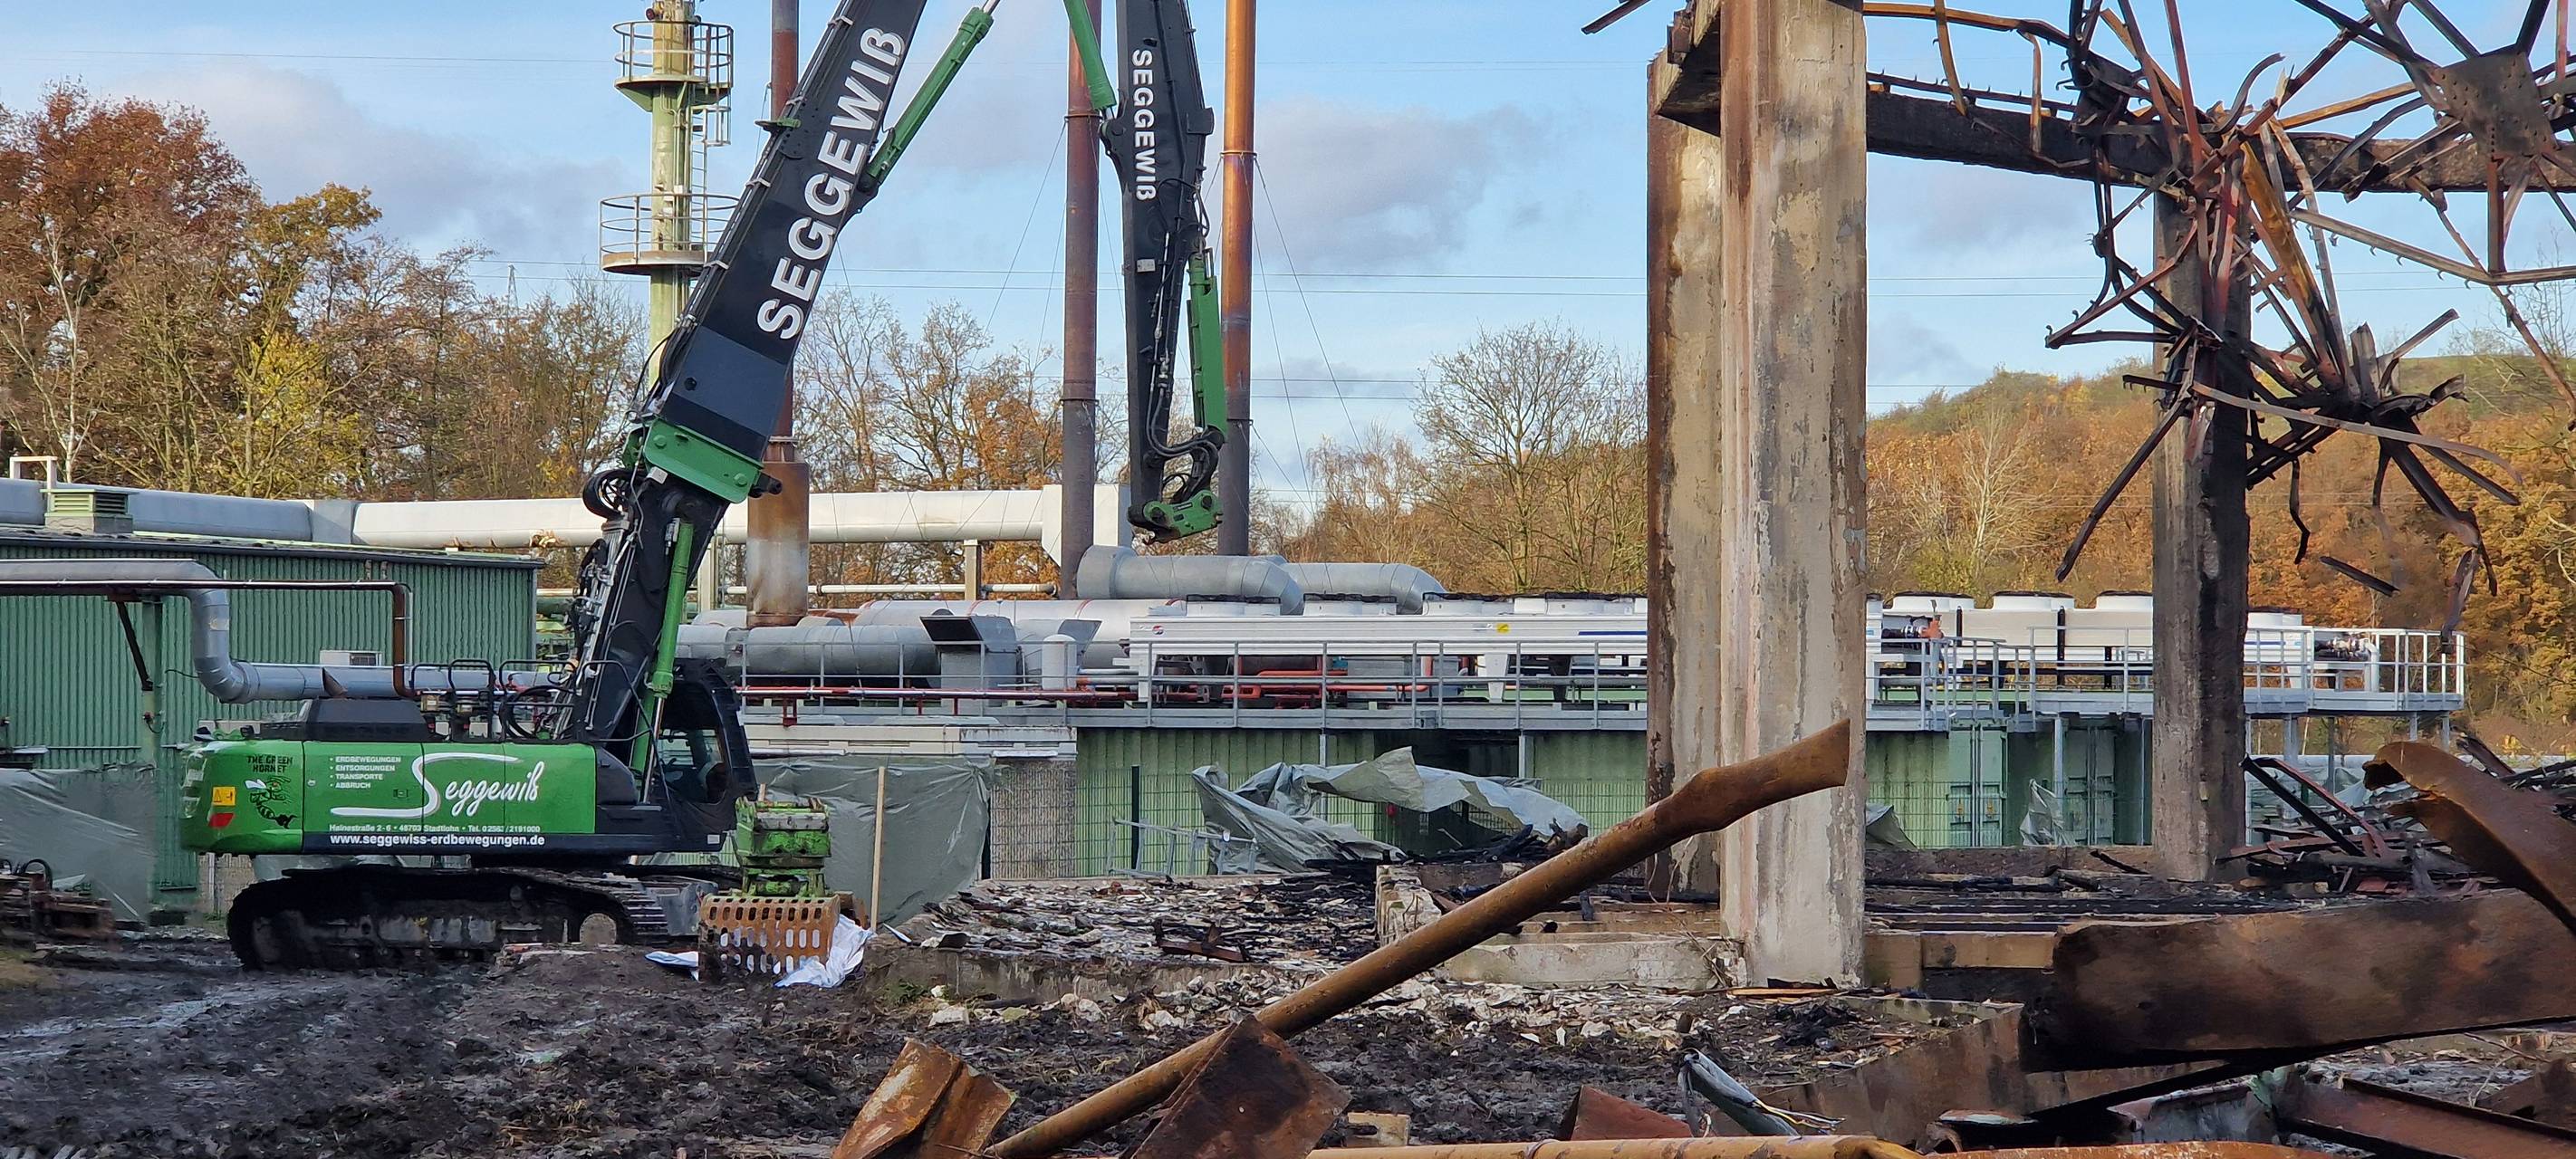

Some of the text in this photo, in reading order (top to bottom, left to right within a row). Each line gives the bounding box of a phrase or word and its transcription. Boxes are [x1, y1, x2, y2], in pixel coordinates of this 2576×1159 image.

[246, 754, 293, 765] THE GREEN
[253, 764, 287, 773] HORNET
[331, 752, 545, 819] Seggewiß
[423, 824, 460, 832] Stadtlohn
[330, 833, 545, 848] www.seggewiss-erdbewegungen.de
